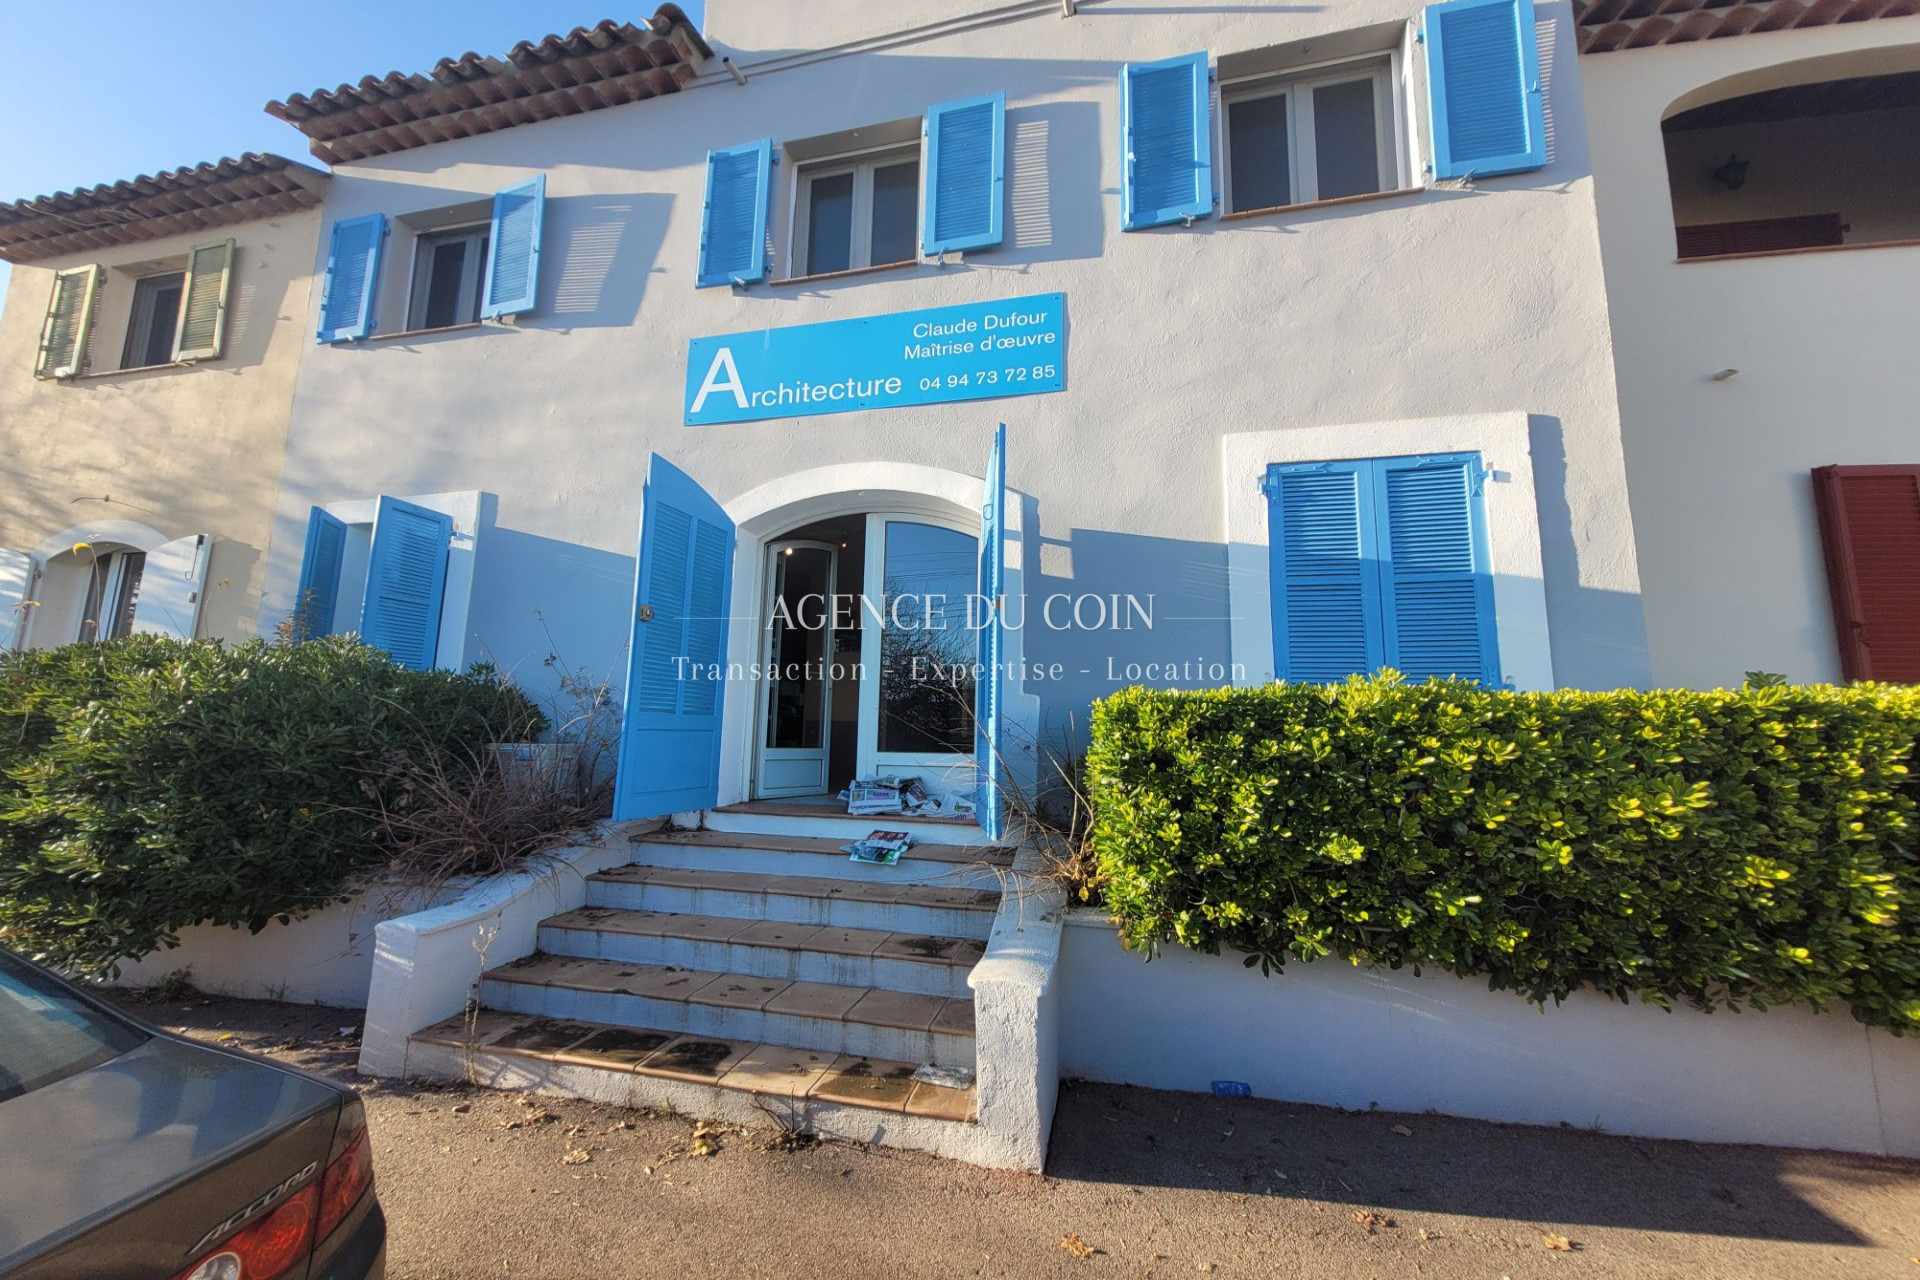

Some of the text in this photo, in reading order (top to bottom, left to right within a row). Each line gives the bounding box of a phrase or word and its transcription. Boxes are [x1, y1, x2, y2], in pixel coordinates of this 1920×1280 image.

[913, 311, 1048, 339] Claude Dufour
[904, 331, 1056, 360] Maîtrise d'œuvre
[690, 347, 902, 413] Architecture
[919, 364, 1056, 391] 04 94 73 72 85
[187, 1161, 318, 1256] ACCORD
